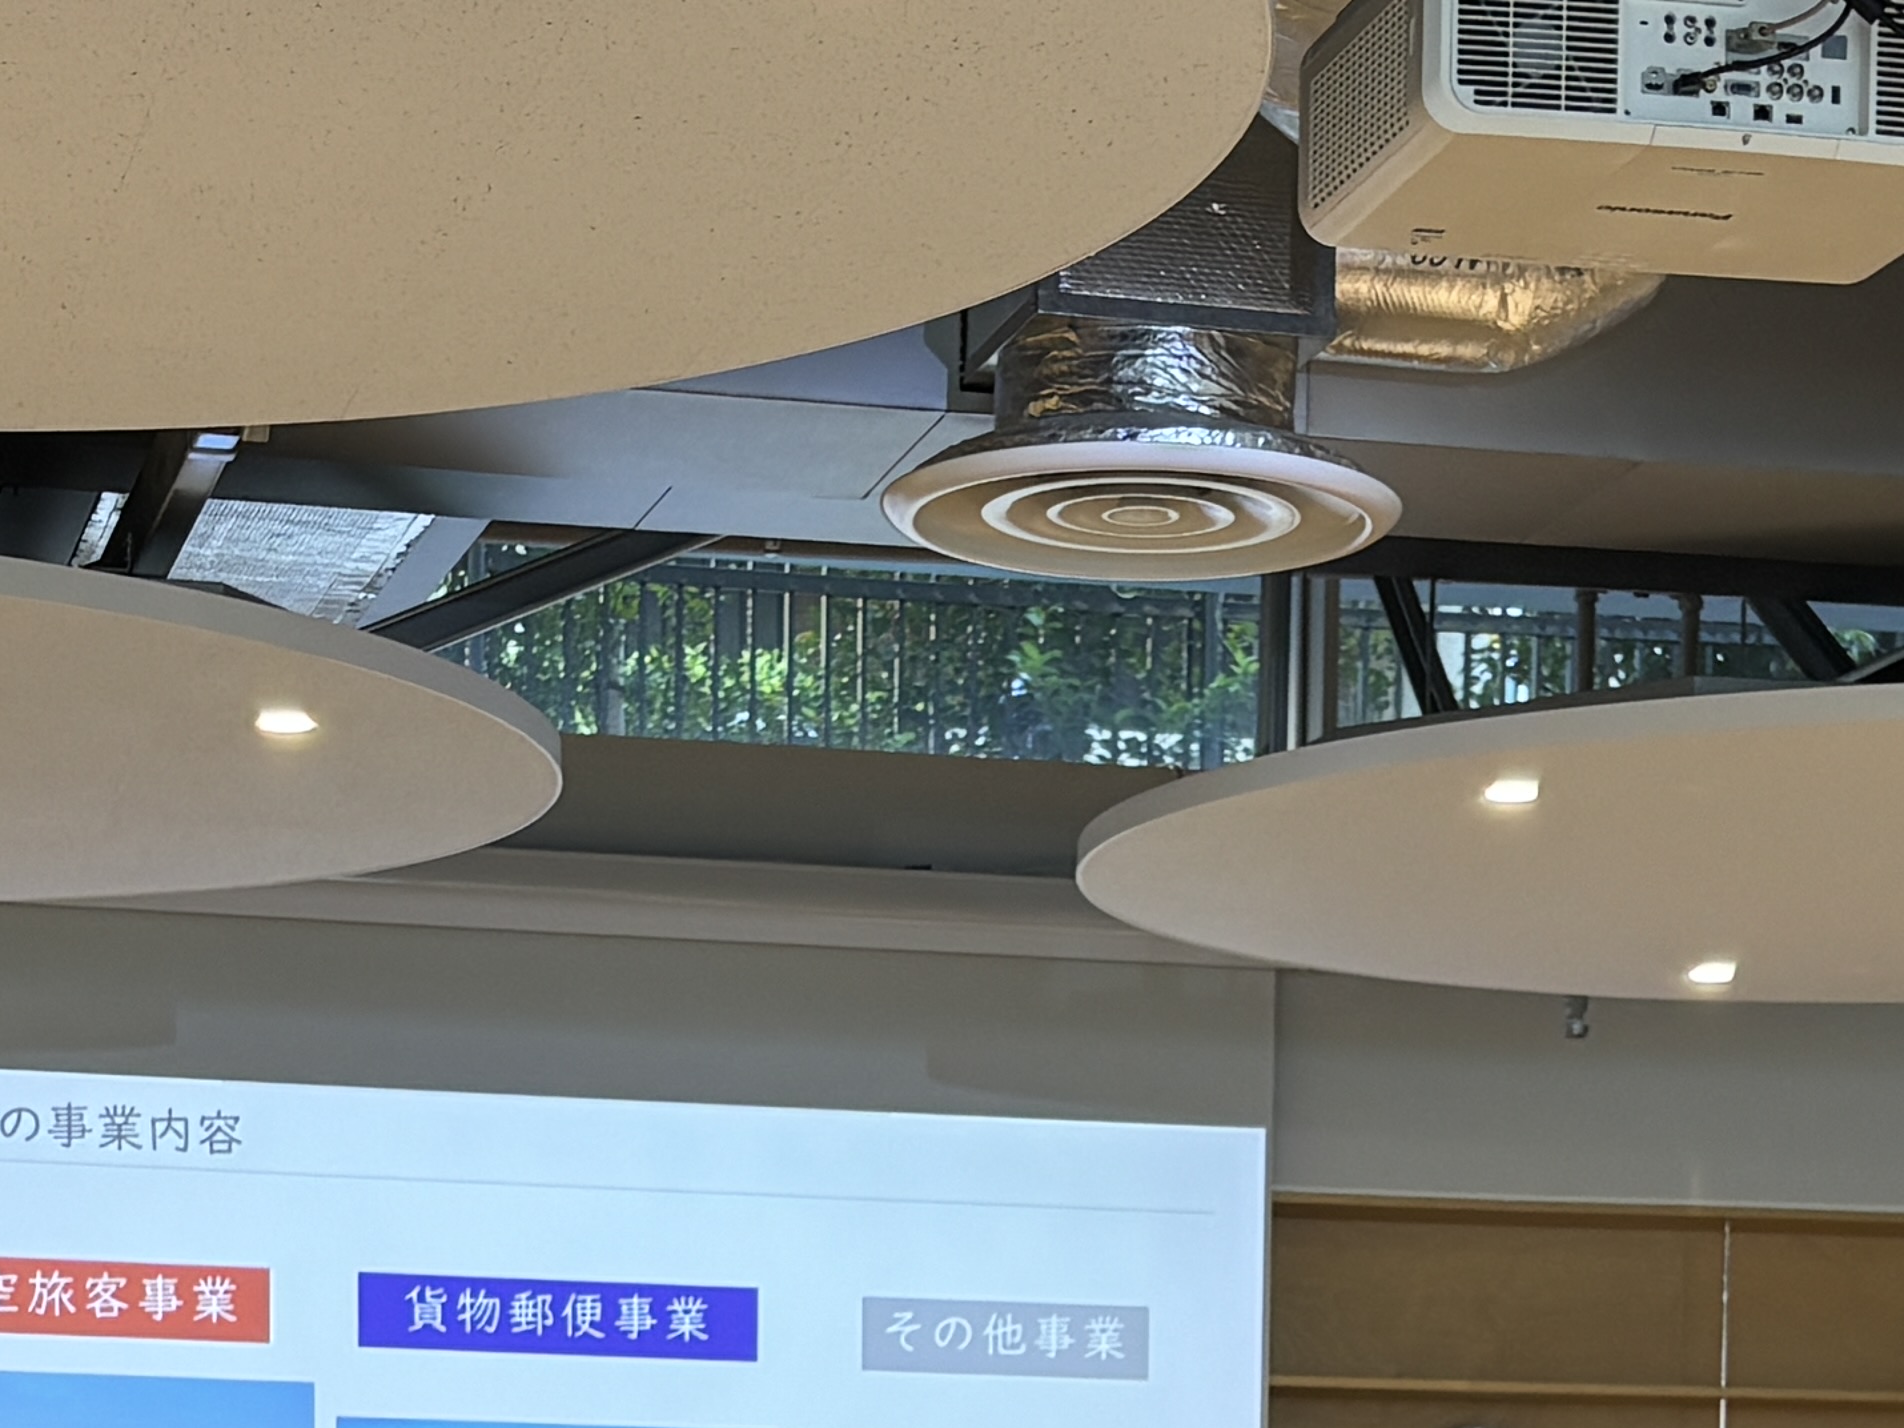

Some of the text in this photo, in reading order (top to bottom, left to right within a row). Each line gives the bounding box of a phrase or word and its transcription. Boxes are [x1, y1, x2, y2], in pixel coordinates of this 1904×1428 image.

[404, 1284, 710, 1343] 貨物郵便事業
[885, 1310, 1126, 1361] その他事業
